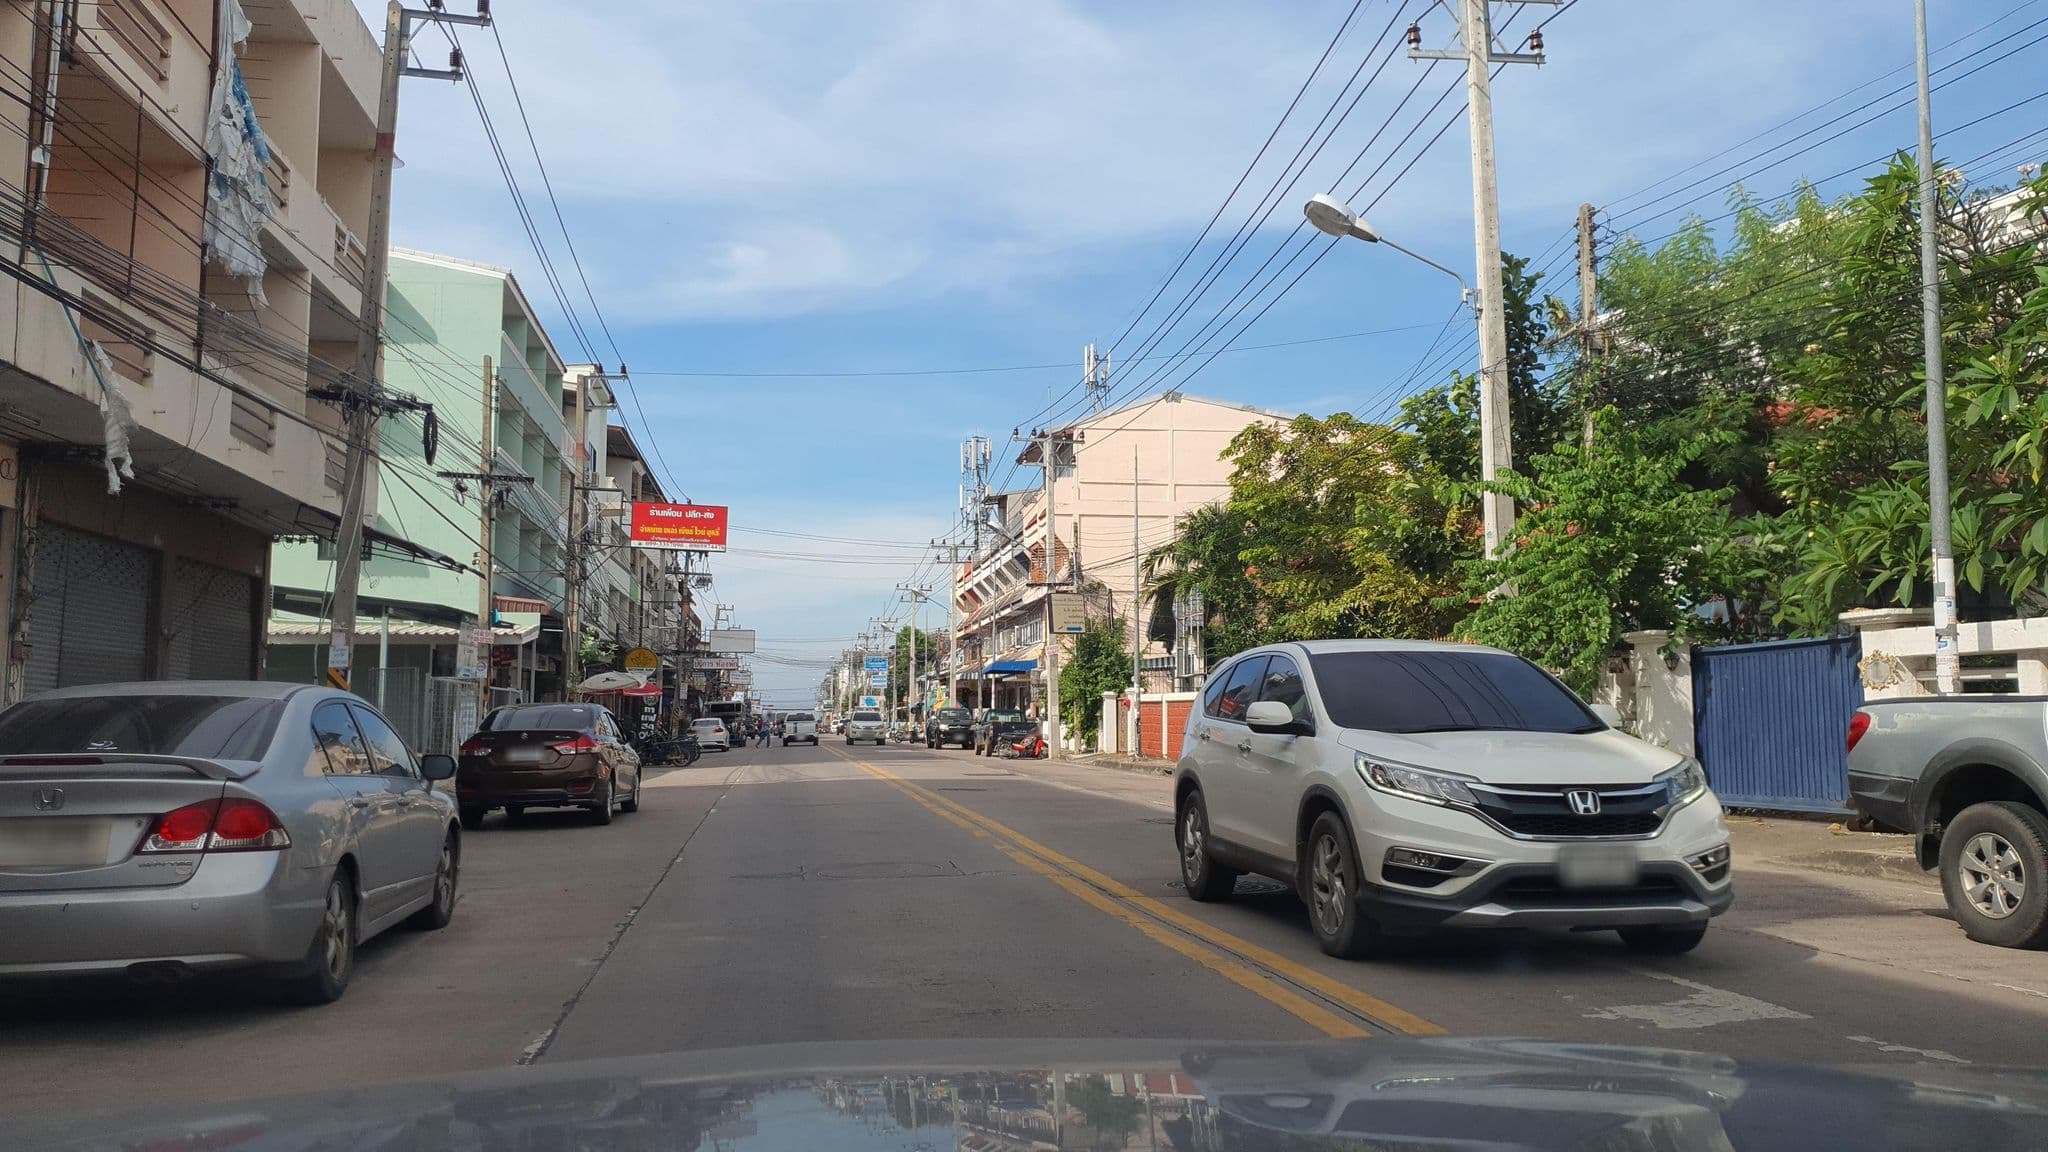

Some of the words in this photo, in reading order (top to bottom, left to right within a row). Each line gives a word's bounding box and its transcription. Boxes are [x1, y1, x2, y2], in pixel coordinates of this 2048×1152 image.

[649, 506, 682, 518] ร้านเพื่อน
[685, 508, 714, 519] ปลีก-ส่ง
